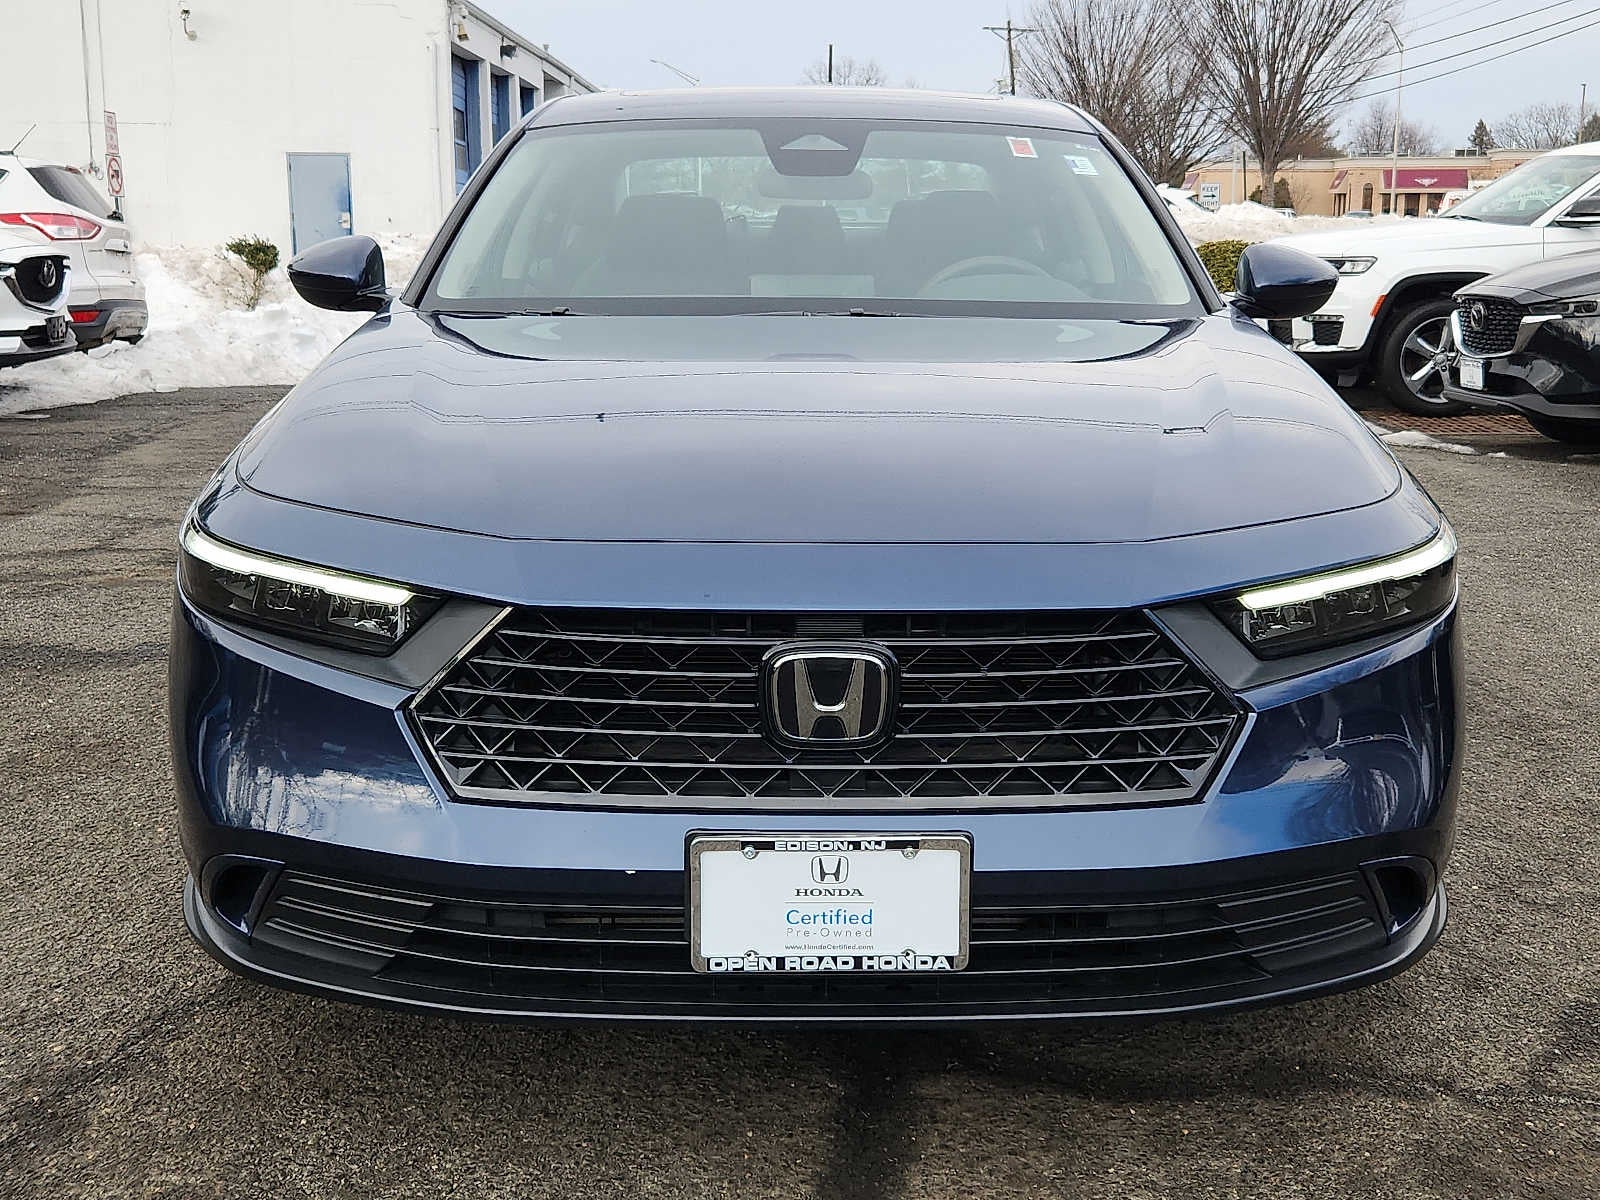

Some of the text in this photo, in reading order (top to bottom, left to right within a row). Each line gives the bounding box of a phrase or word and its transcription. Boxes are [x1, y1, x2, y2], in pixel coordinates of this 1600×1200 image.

[860, 840, 887, 850] NJ
[794, 888, 864, 897] HONDA
[786, 908, 873, 925] Certified
[786, 927, 872, 938] Pre-Owned
[784, 943, 874, 951] www.HondaCertified.com
[709, 956, 951, 971] OPEN ROAD HONDA
